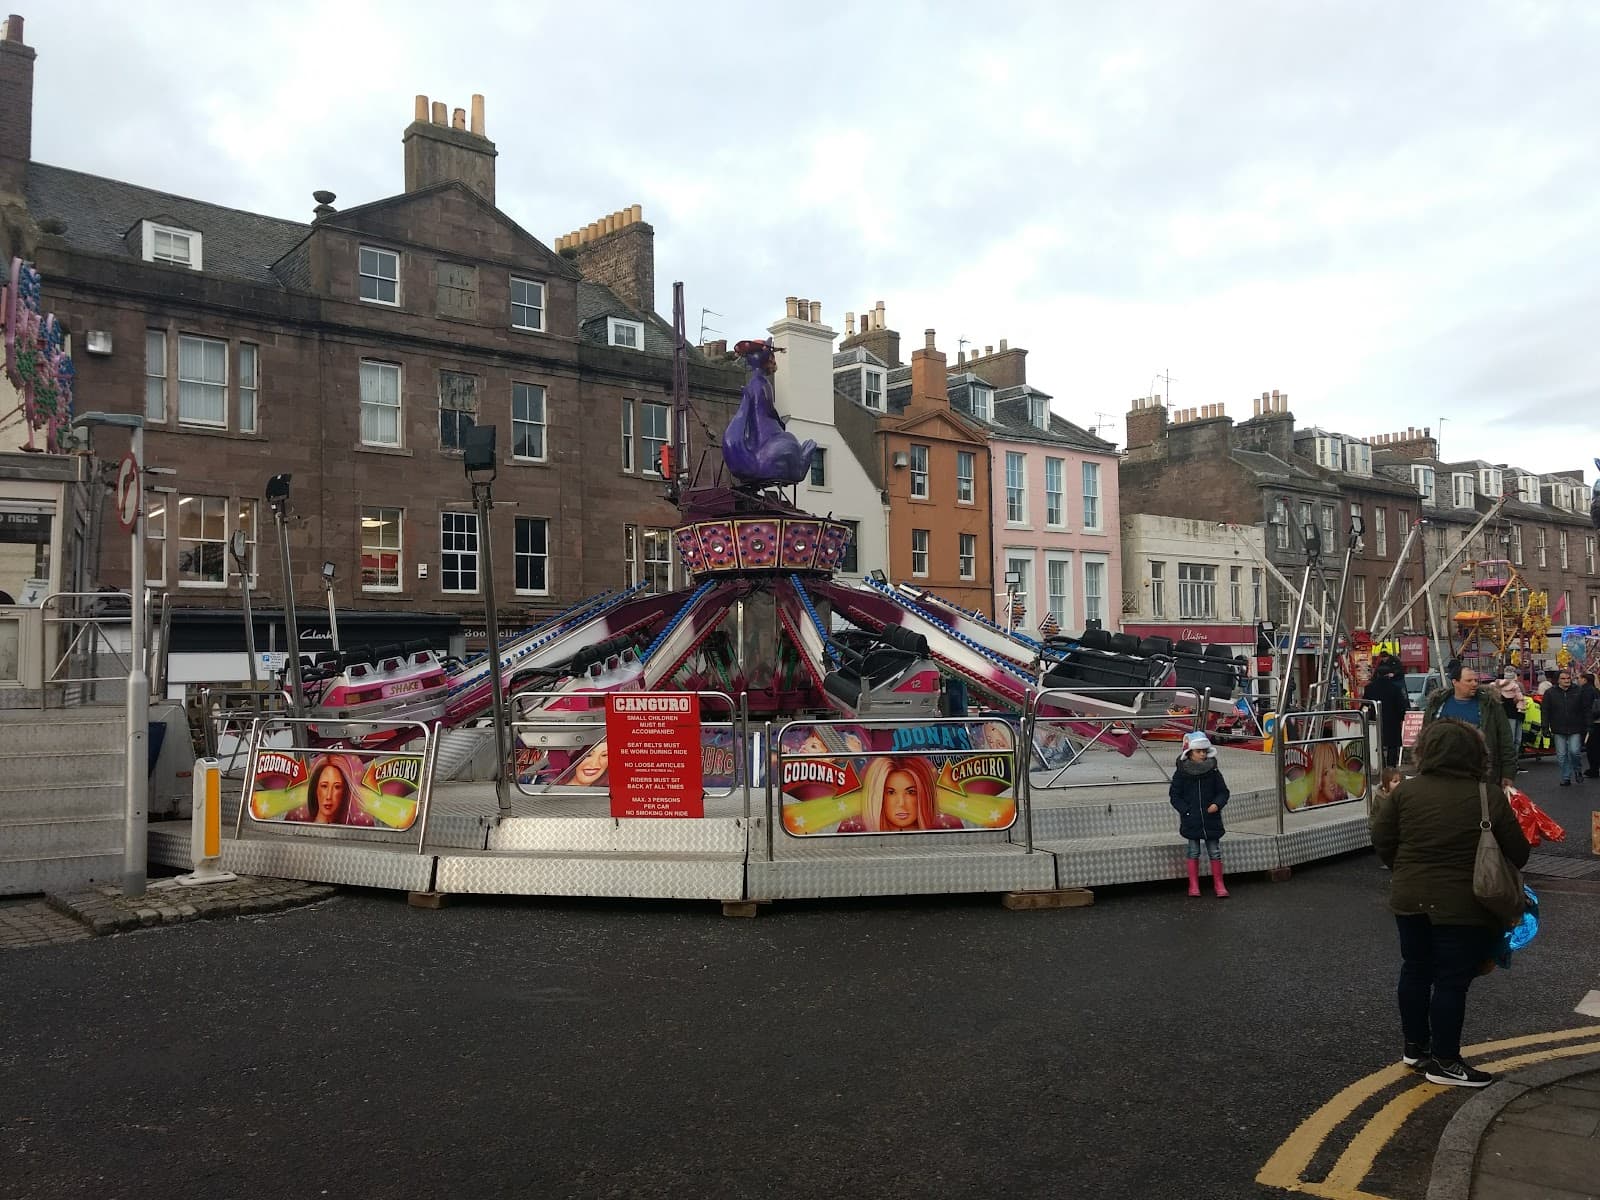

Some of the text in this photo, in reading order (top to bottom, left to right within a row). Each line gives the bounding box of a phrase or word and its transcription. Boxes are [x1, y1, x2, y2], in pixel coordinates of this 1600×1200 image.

[299, 628, 334, 640] Clark
[390, 681, 420, 695] SHAKE
[911, 679, 921, 689] 12
[615, 697, 689, 711] CANGURO
[257, 755, 418, 781] CODONA'S CANGURO
[783, 761, 846, 786] CODONA'S
[951, 757, 1005, 782] CANGURO
